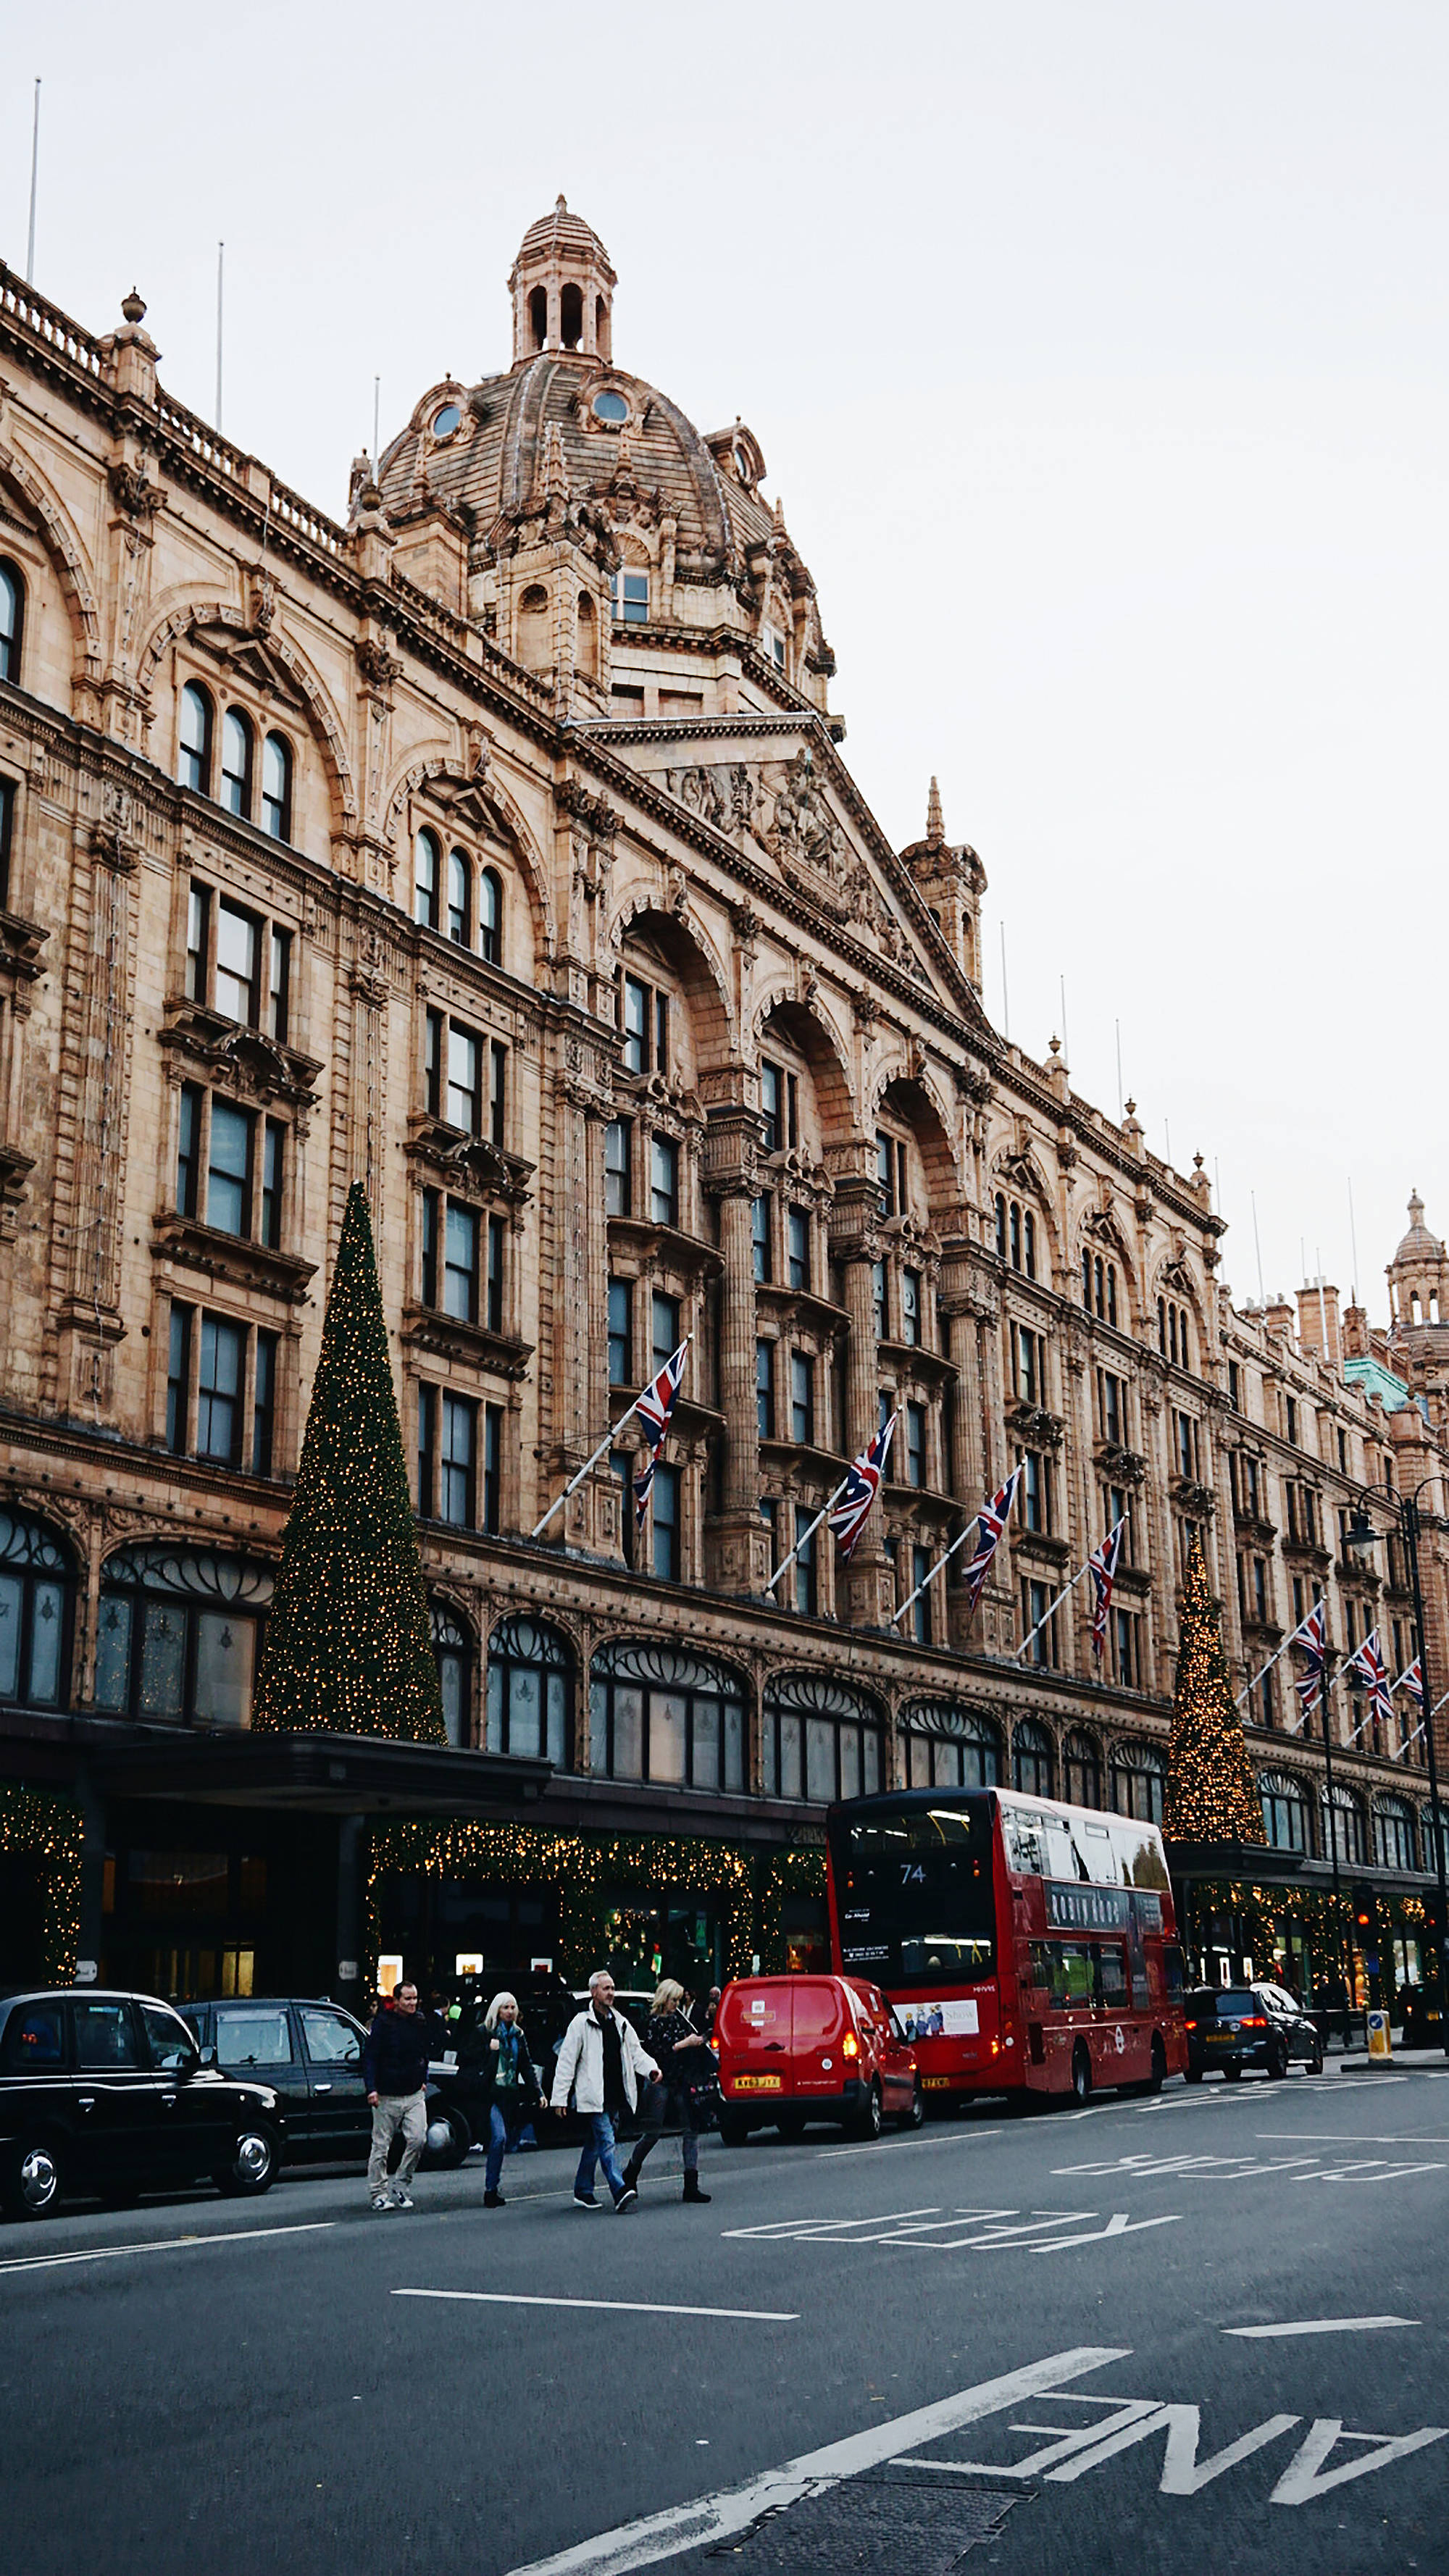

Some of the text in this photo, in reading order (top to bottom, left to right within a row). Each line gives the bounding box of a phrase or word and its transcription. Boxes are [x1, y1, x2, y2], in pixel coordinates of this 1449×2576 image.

[900, 1864, 927, 1884] 74
[1050, 2154, 1449, 2182] CLEAR
[720, 2207, 1182, 2253] KEEP
[888, 2392, 1449, 2505] ANE
